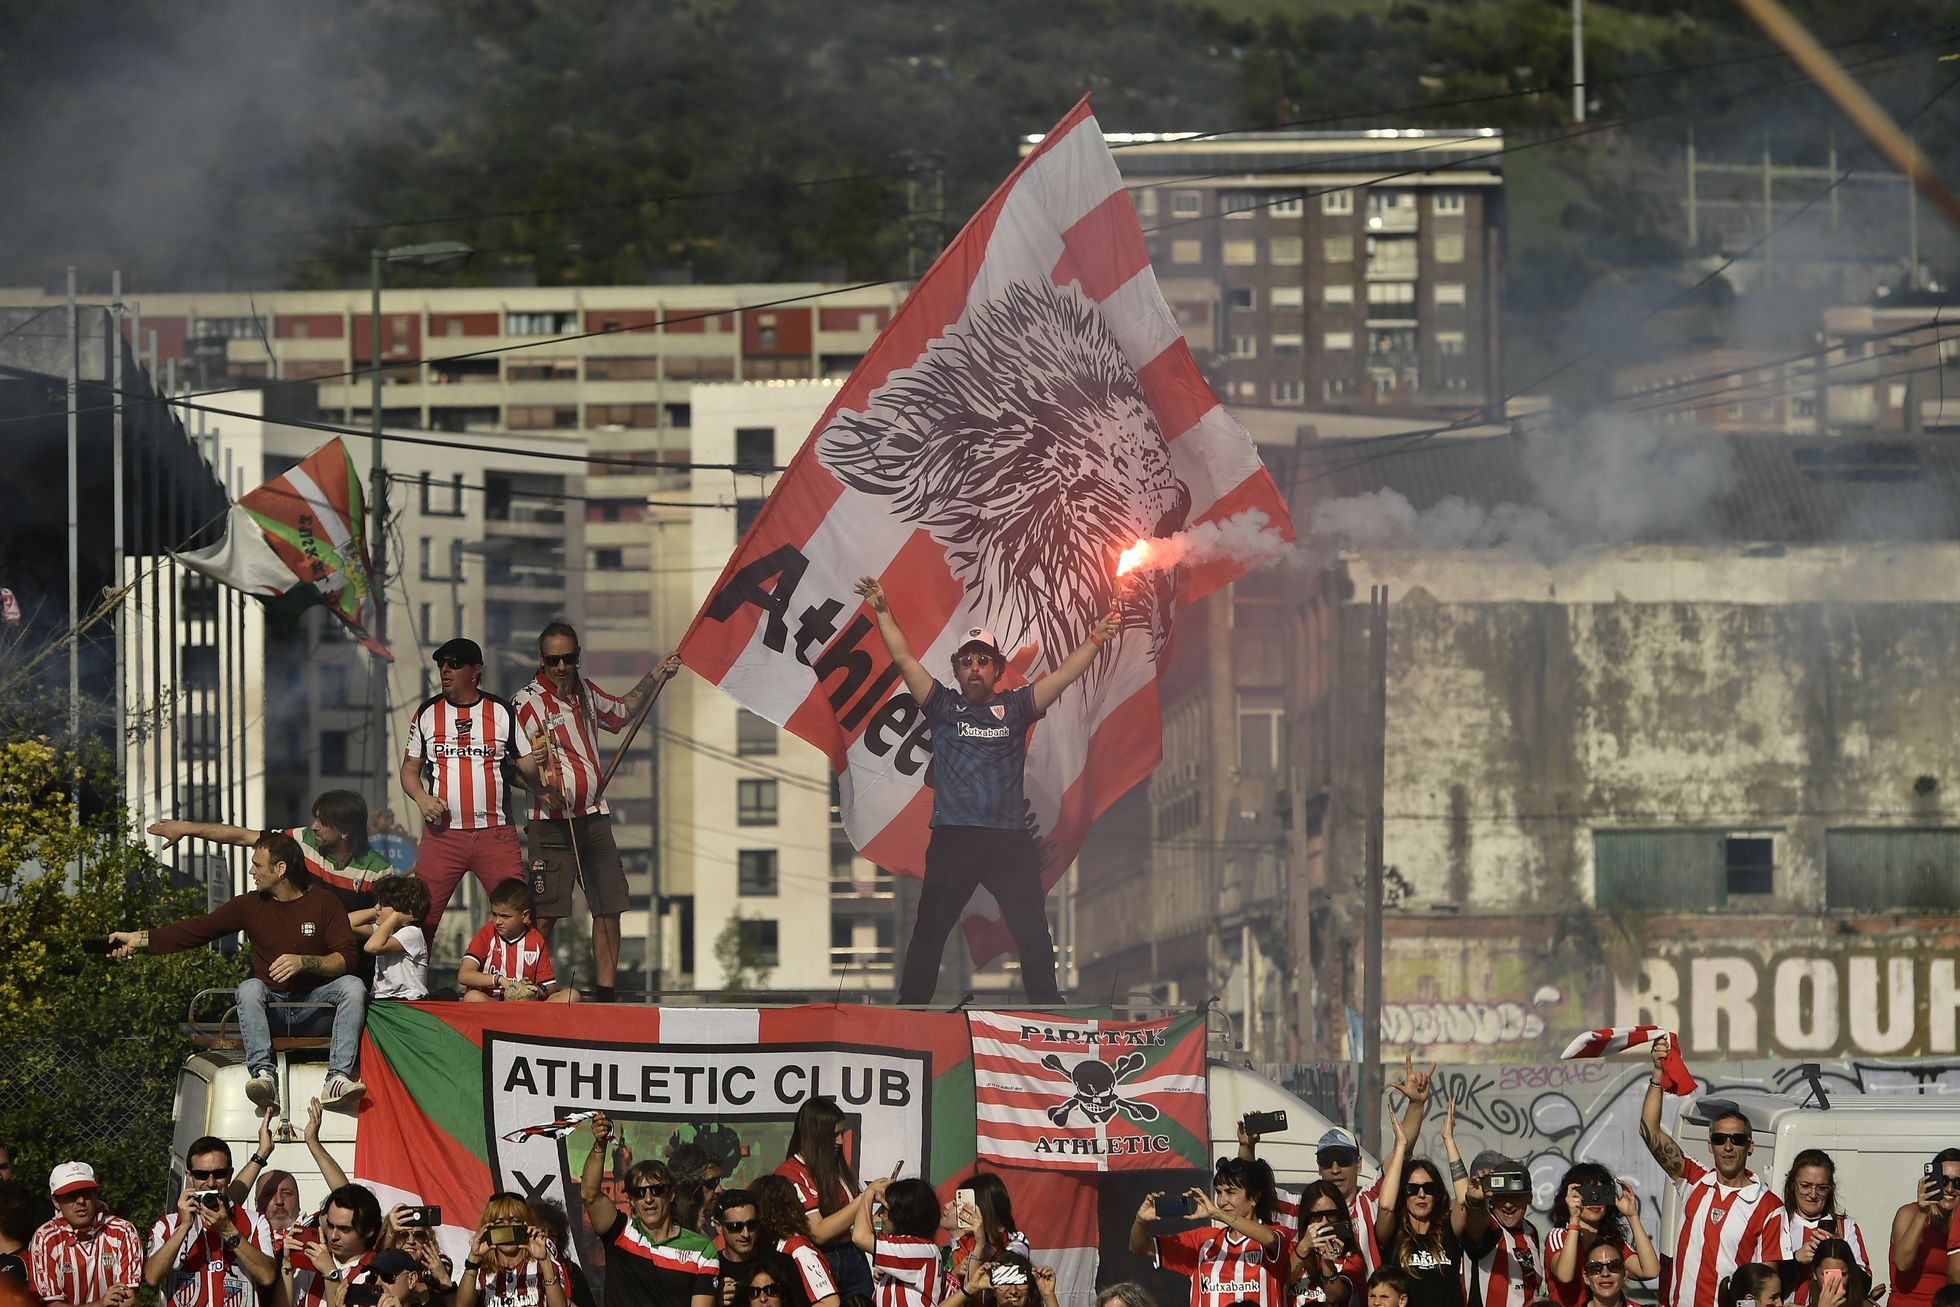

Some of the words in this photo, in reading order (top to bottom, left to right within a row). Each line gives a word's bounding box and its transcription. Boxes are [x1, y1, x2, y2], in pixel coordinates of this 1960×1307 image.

[957, 722, 1010, 738] Kutxabank
[434, 744, 495, 758] Piratak
[503, 1055, 756, 1106] ATHLETIC
[773, 1064, 912, 1107] CLUB
[1034, 1134, 1170, 1156] ATHLETIC
[1200, 1274, 1260, 1294] Kutxabank
